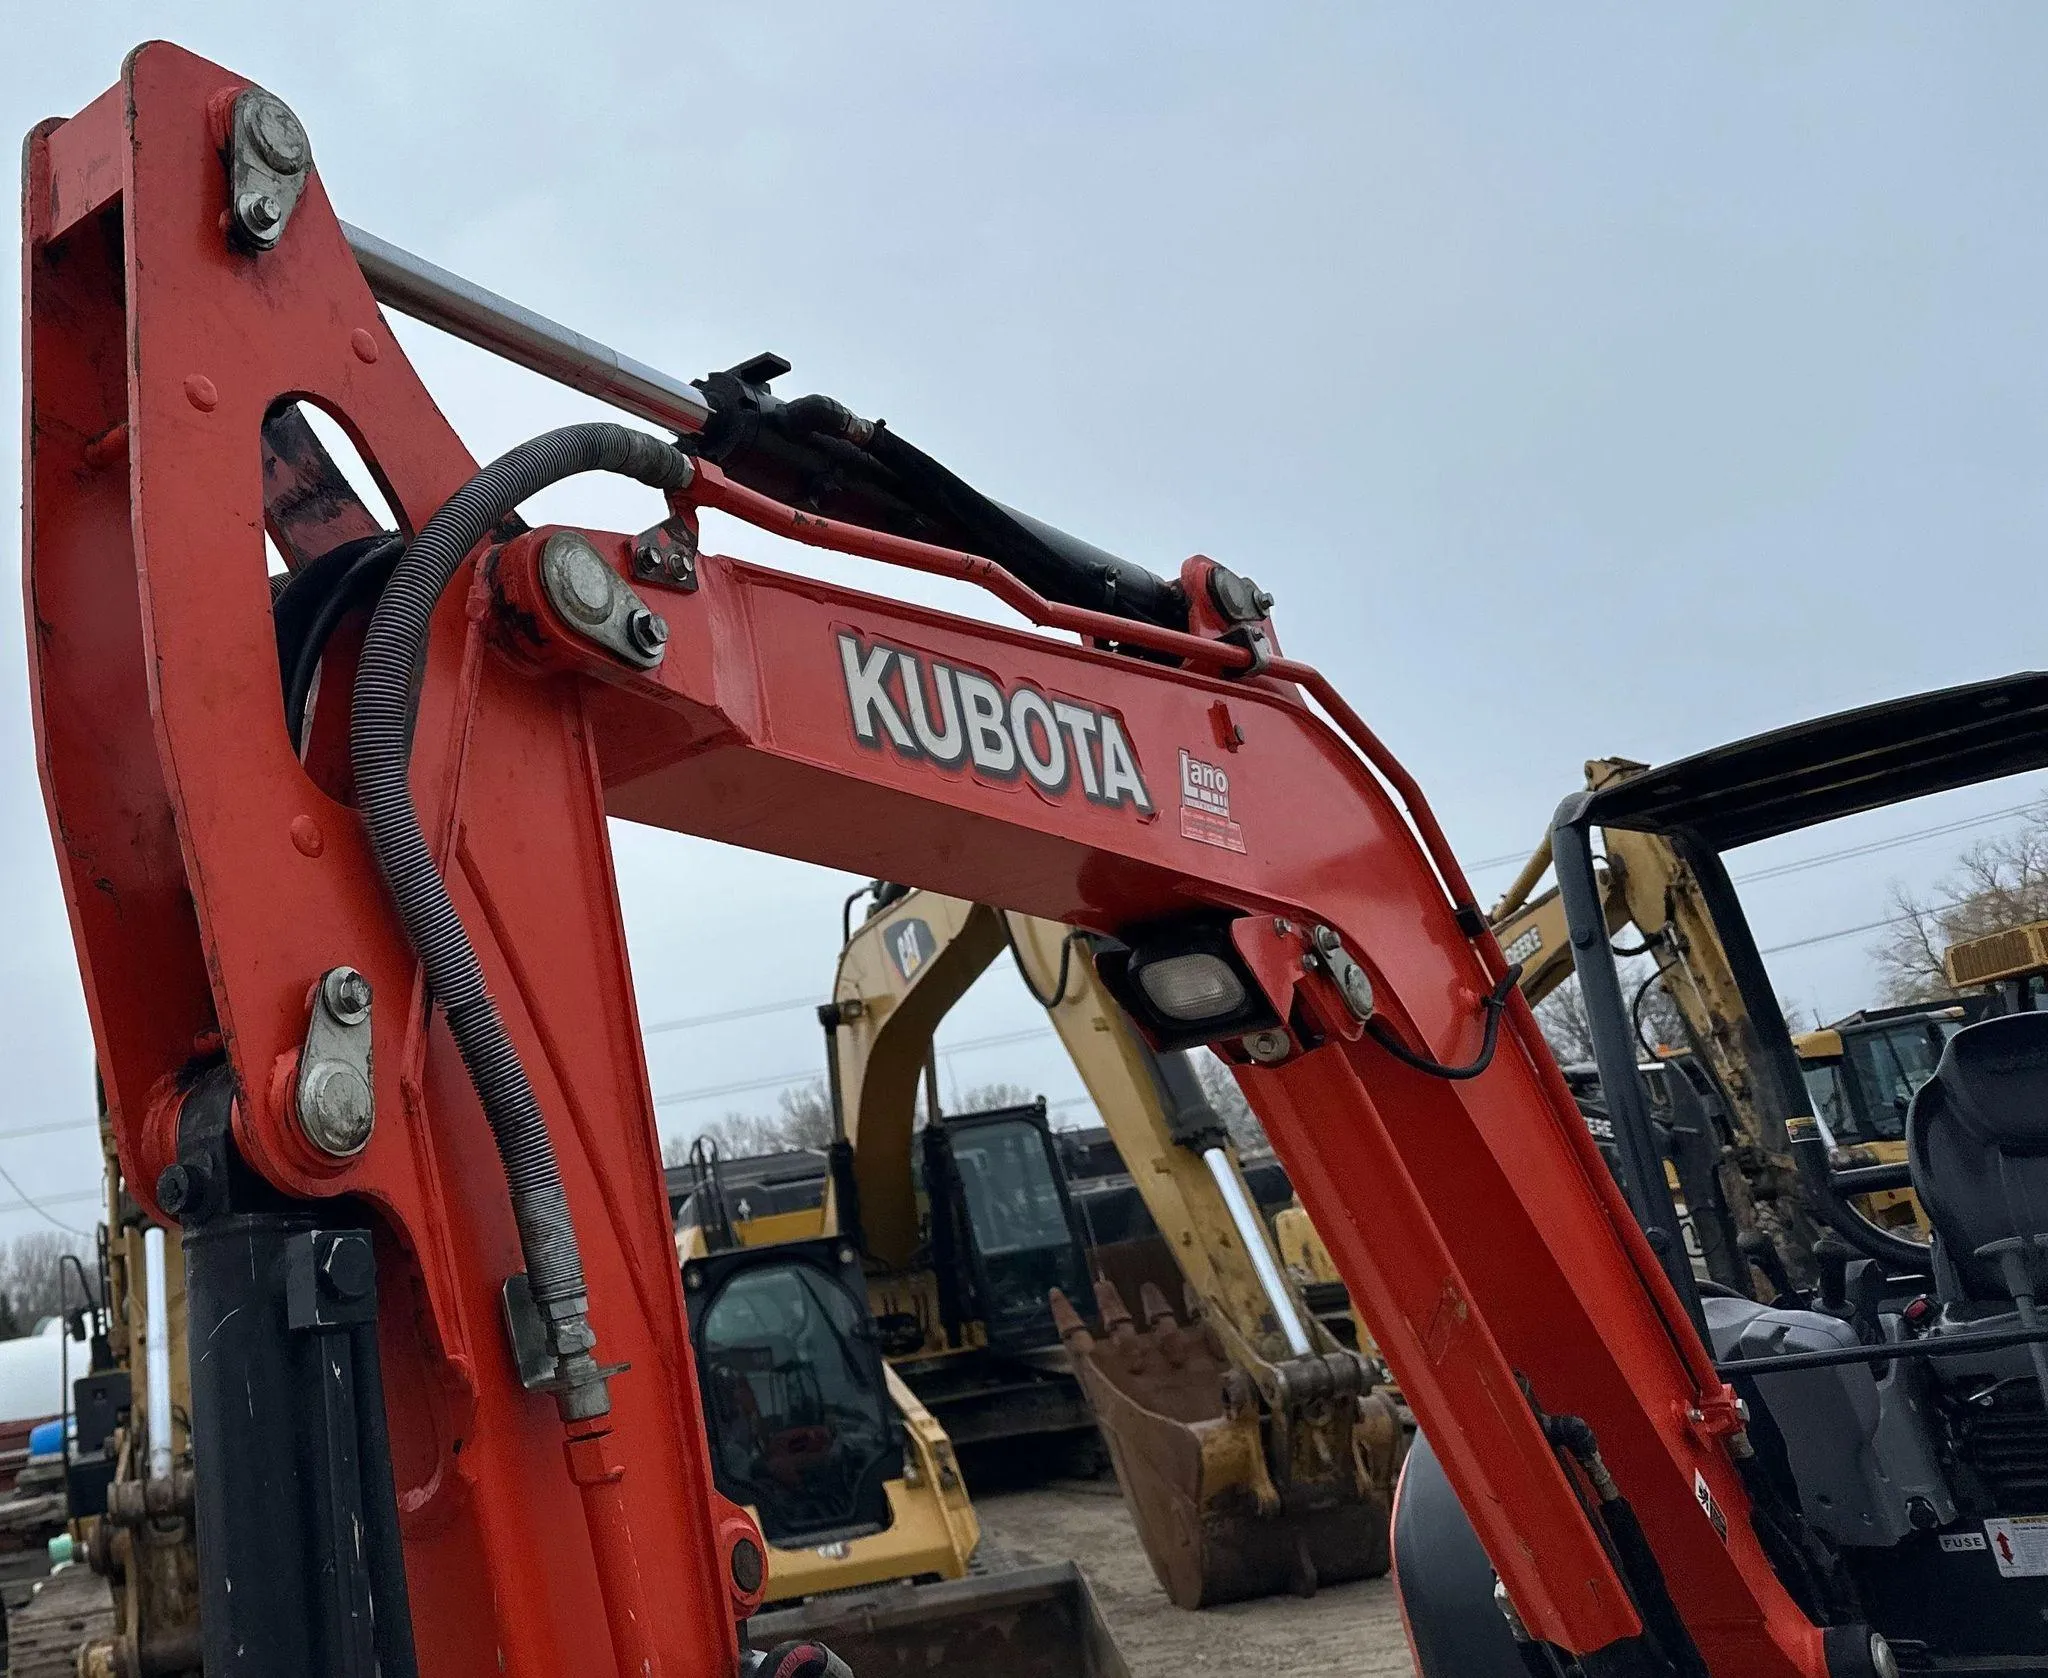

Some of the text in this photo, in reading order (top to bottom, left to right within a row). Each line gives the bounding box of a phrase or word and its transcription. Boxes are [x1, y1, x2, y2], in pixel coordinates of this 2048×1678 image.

[838, 635, 1149, 808] KUBOTA
[1181, 752, 1228, 799] Lano
[1943, 1537, 1983, 1548] FUSE
